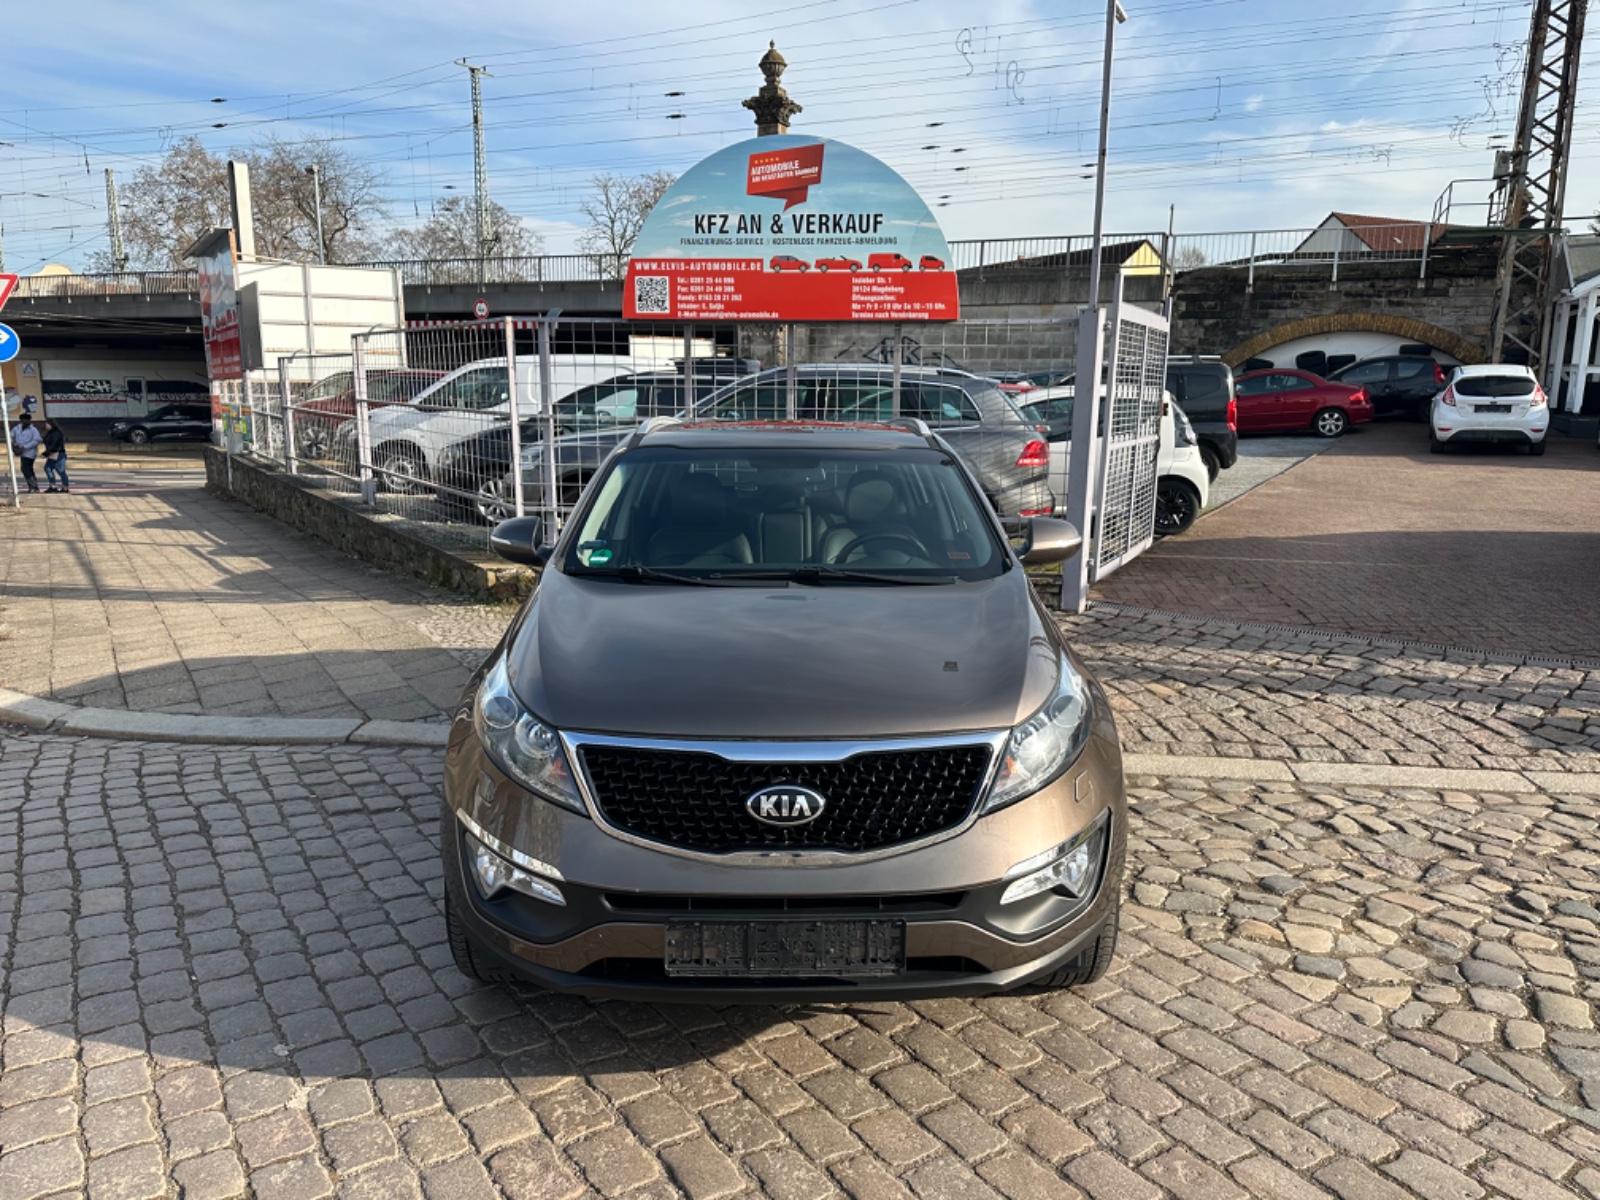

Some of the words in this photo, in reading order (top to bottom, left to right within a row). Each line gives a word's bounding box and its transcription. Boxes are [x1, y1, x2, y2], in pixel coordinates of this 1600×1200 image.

[752, 160, 799, 175] AUTOMOBILE
[694, 214, 729, 234] KFZ
[736, 214, 762, 234] AN
[770, 214, 784, 234] &
[792, 214, 883, 234] VERKAUF
[635, 262, 761, 270] WWW.ELVIS-AUTOMOBILE.DE
[760, 795, 812, 816] KIA
